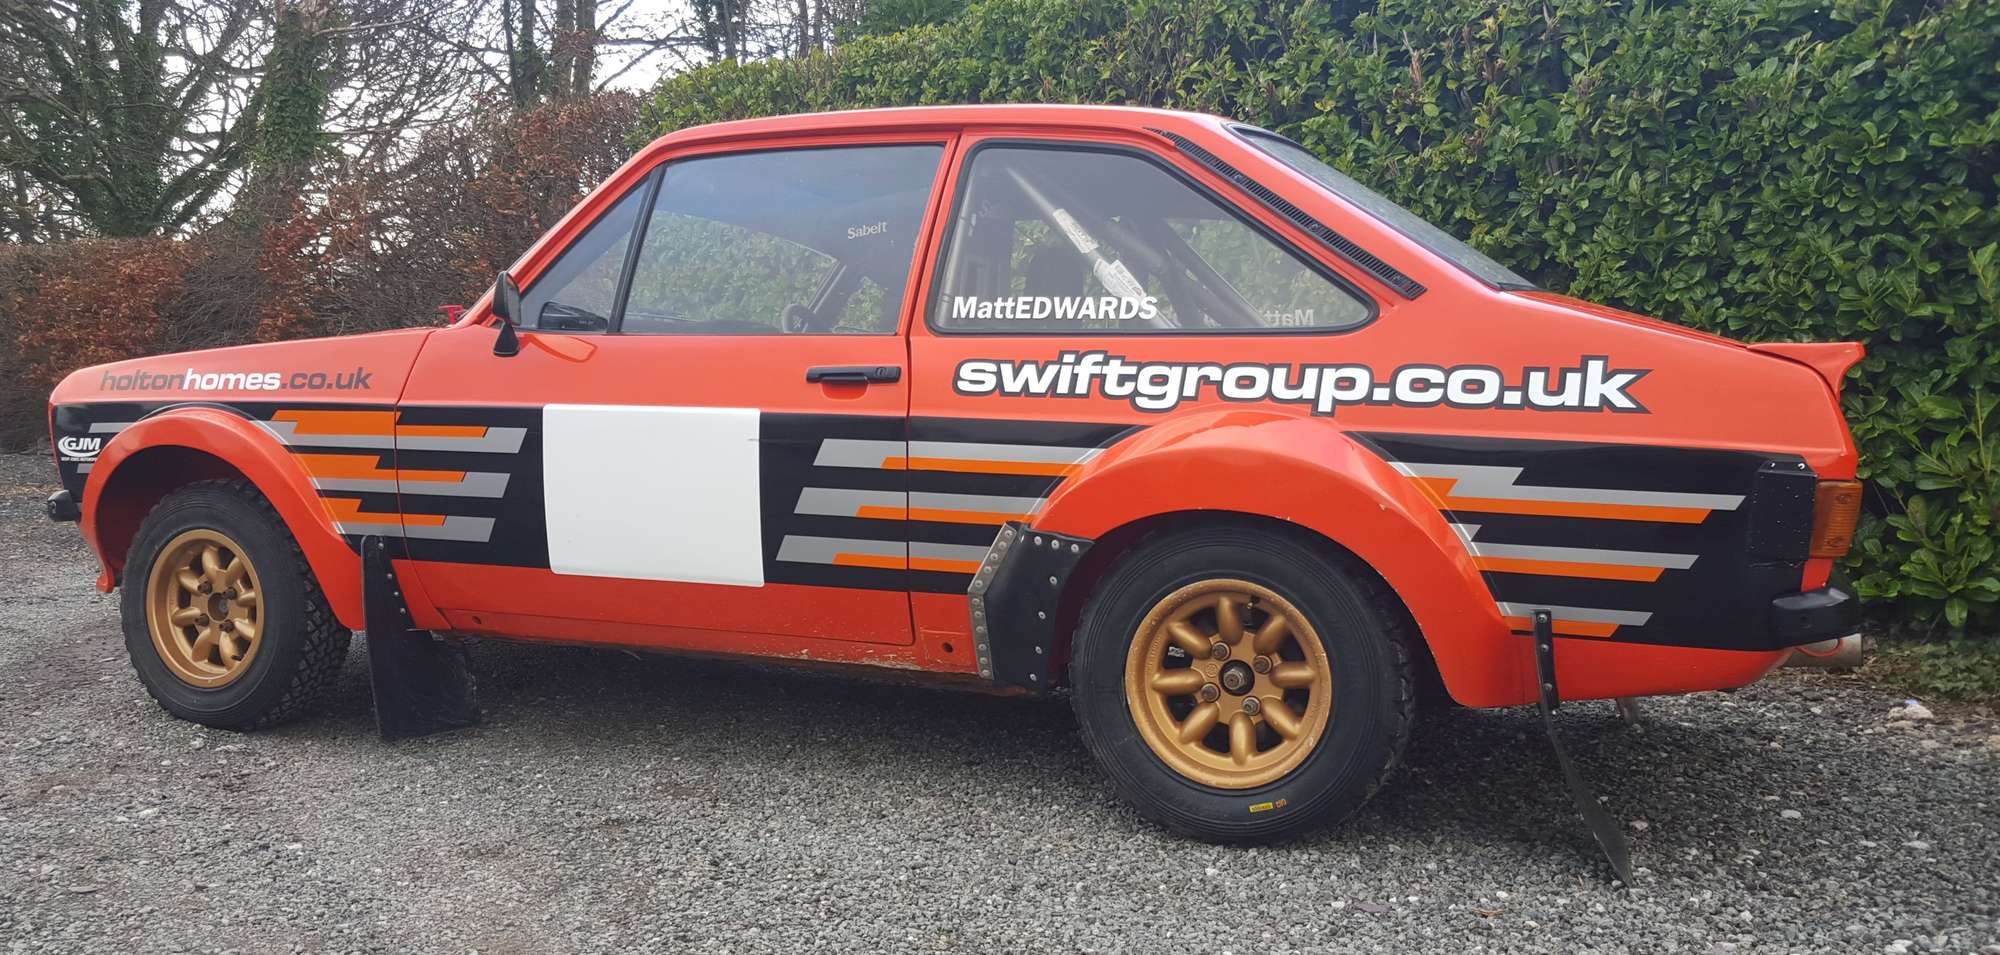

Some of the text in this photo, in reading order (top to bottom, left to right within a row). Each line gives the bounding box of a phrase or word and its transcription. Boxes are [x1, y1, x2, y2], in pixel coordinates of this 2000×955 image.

[952, 296, 1158, 320] MattEDWARDS
[100, 367, 372, 391] holtonhomes.co.uk
[953, 350, 1652, 416] swiftgroup.co.uk
[64, 437, 101, 450] GJM
